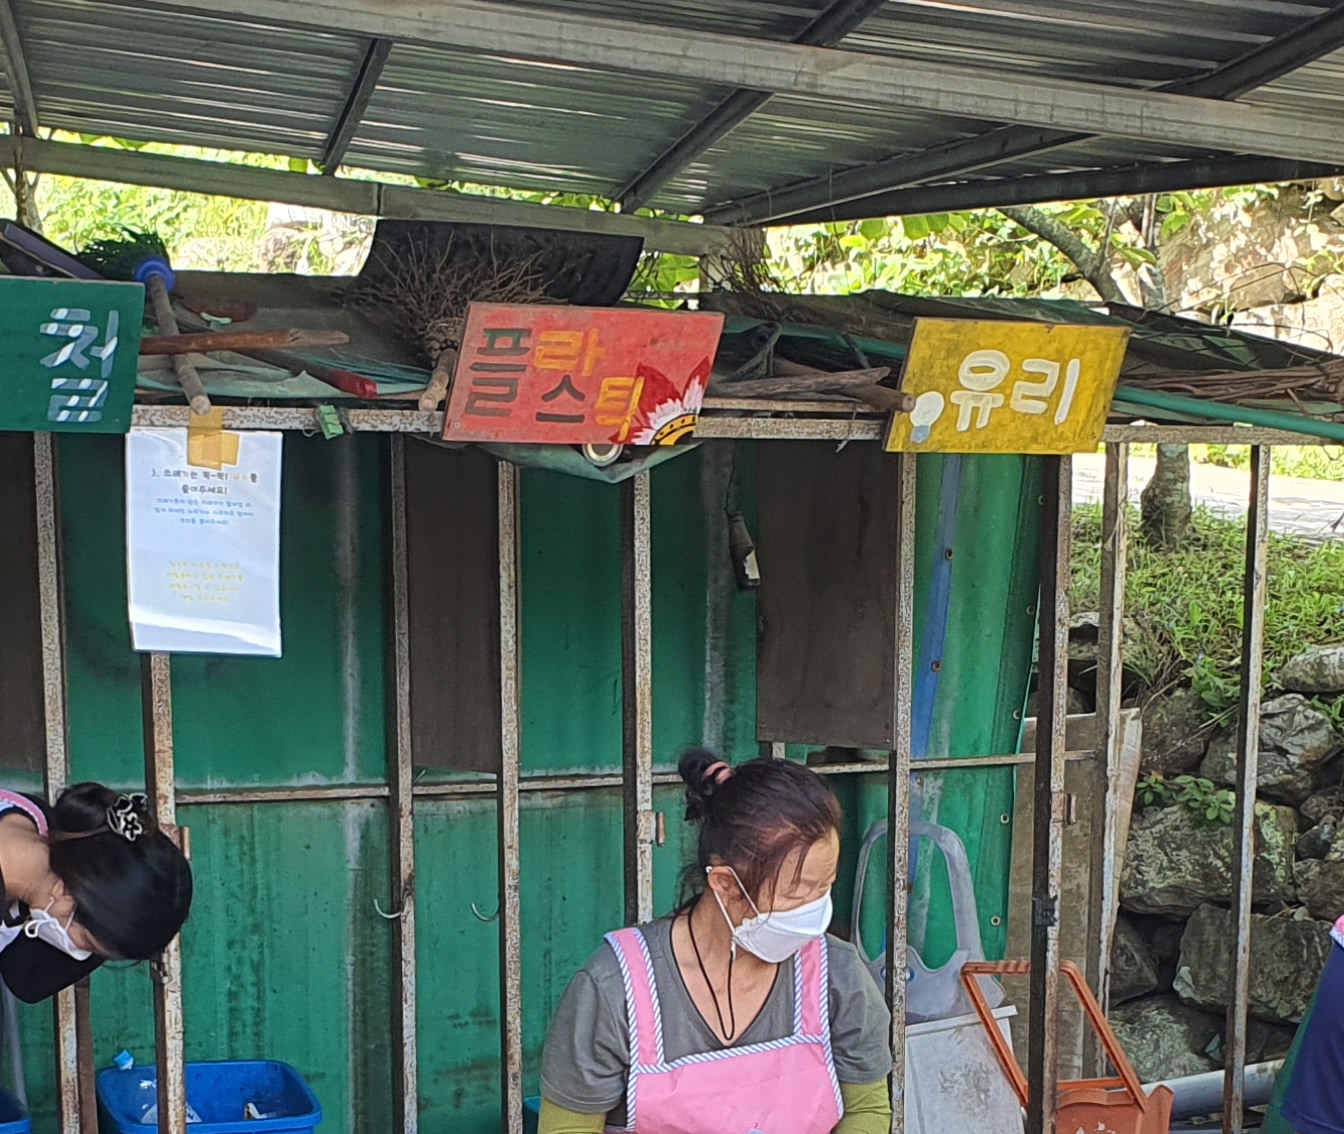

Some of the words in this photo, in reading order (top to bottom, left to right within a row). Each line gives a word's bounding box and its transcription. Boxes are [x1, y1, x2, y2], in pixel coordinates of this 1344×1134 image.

[40, 308, 119, 422] 철
[465, 328, 645, 442] 플라스틱
[950, 349, 1081, 432] 유리
